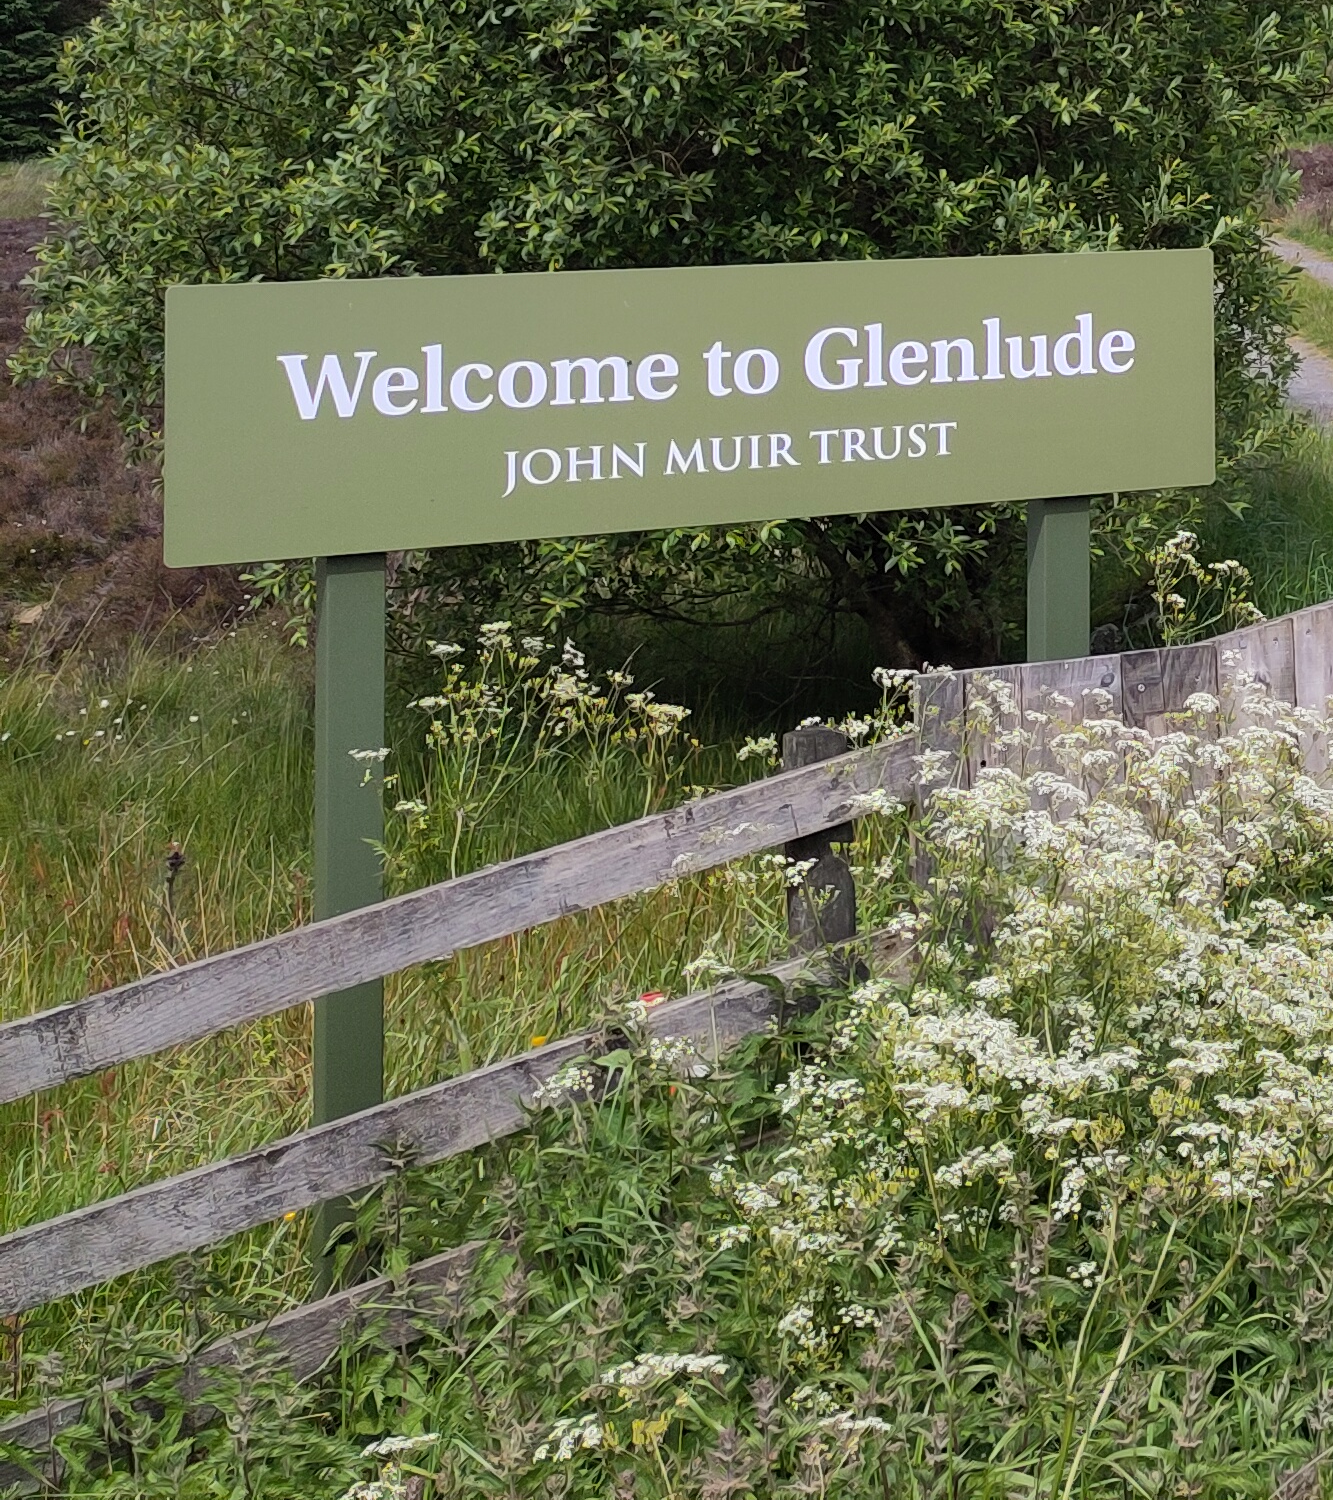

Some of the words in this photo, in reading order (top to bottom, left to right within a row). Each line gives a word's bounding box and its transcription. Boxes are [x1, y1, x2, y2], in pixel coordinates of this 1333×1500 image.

[276, 343, 679, 420] Welcome
[702, 340, 780, 397] to
[804, 312, 1136, 390] Glenlude
[502, 442, 647, 498] JOHN
[663, 432, 801, 475] MUIR
[808, 420, 958, 464] TRUST
